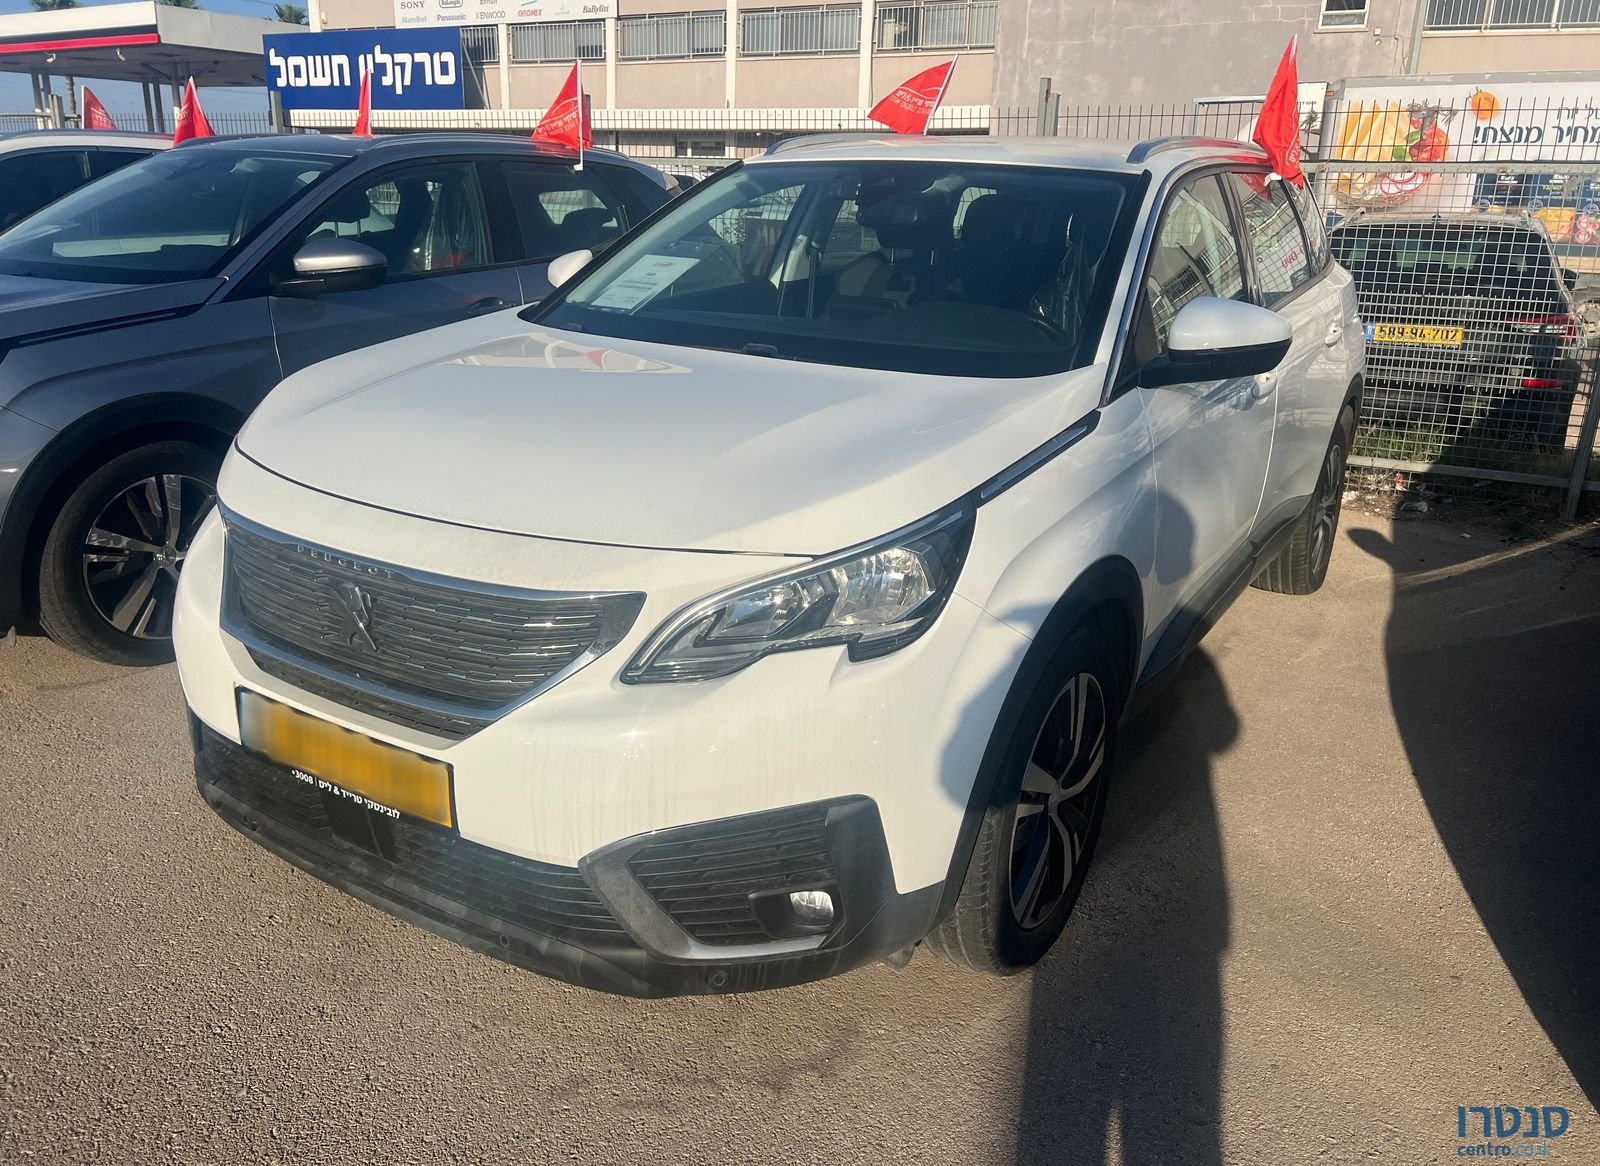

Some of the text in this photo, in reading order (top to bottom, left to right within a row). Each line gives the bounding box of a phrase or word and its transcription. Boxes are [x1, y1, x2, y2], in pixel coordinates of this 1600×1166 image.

[400, 1, 425, 9] SONY
[437, 13, 466, 21] Panasonic
[269, 45, 456, 94] טרקלין חשמל
[1473, 125, 1543, 144] מנצח!
[297, 544, 392, 579] PEUGEOT
[318, 779, 332, 792] ליס
[333, 785, 340, 795] &
[341, 789, 363, 804] טרייד
[364, 798, 400, 819] לובינסקי
